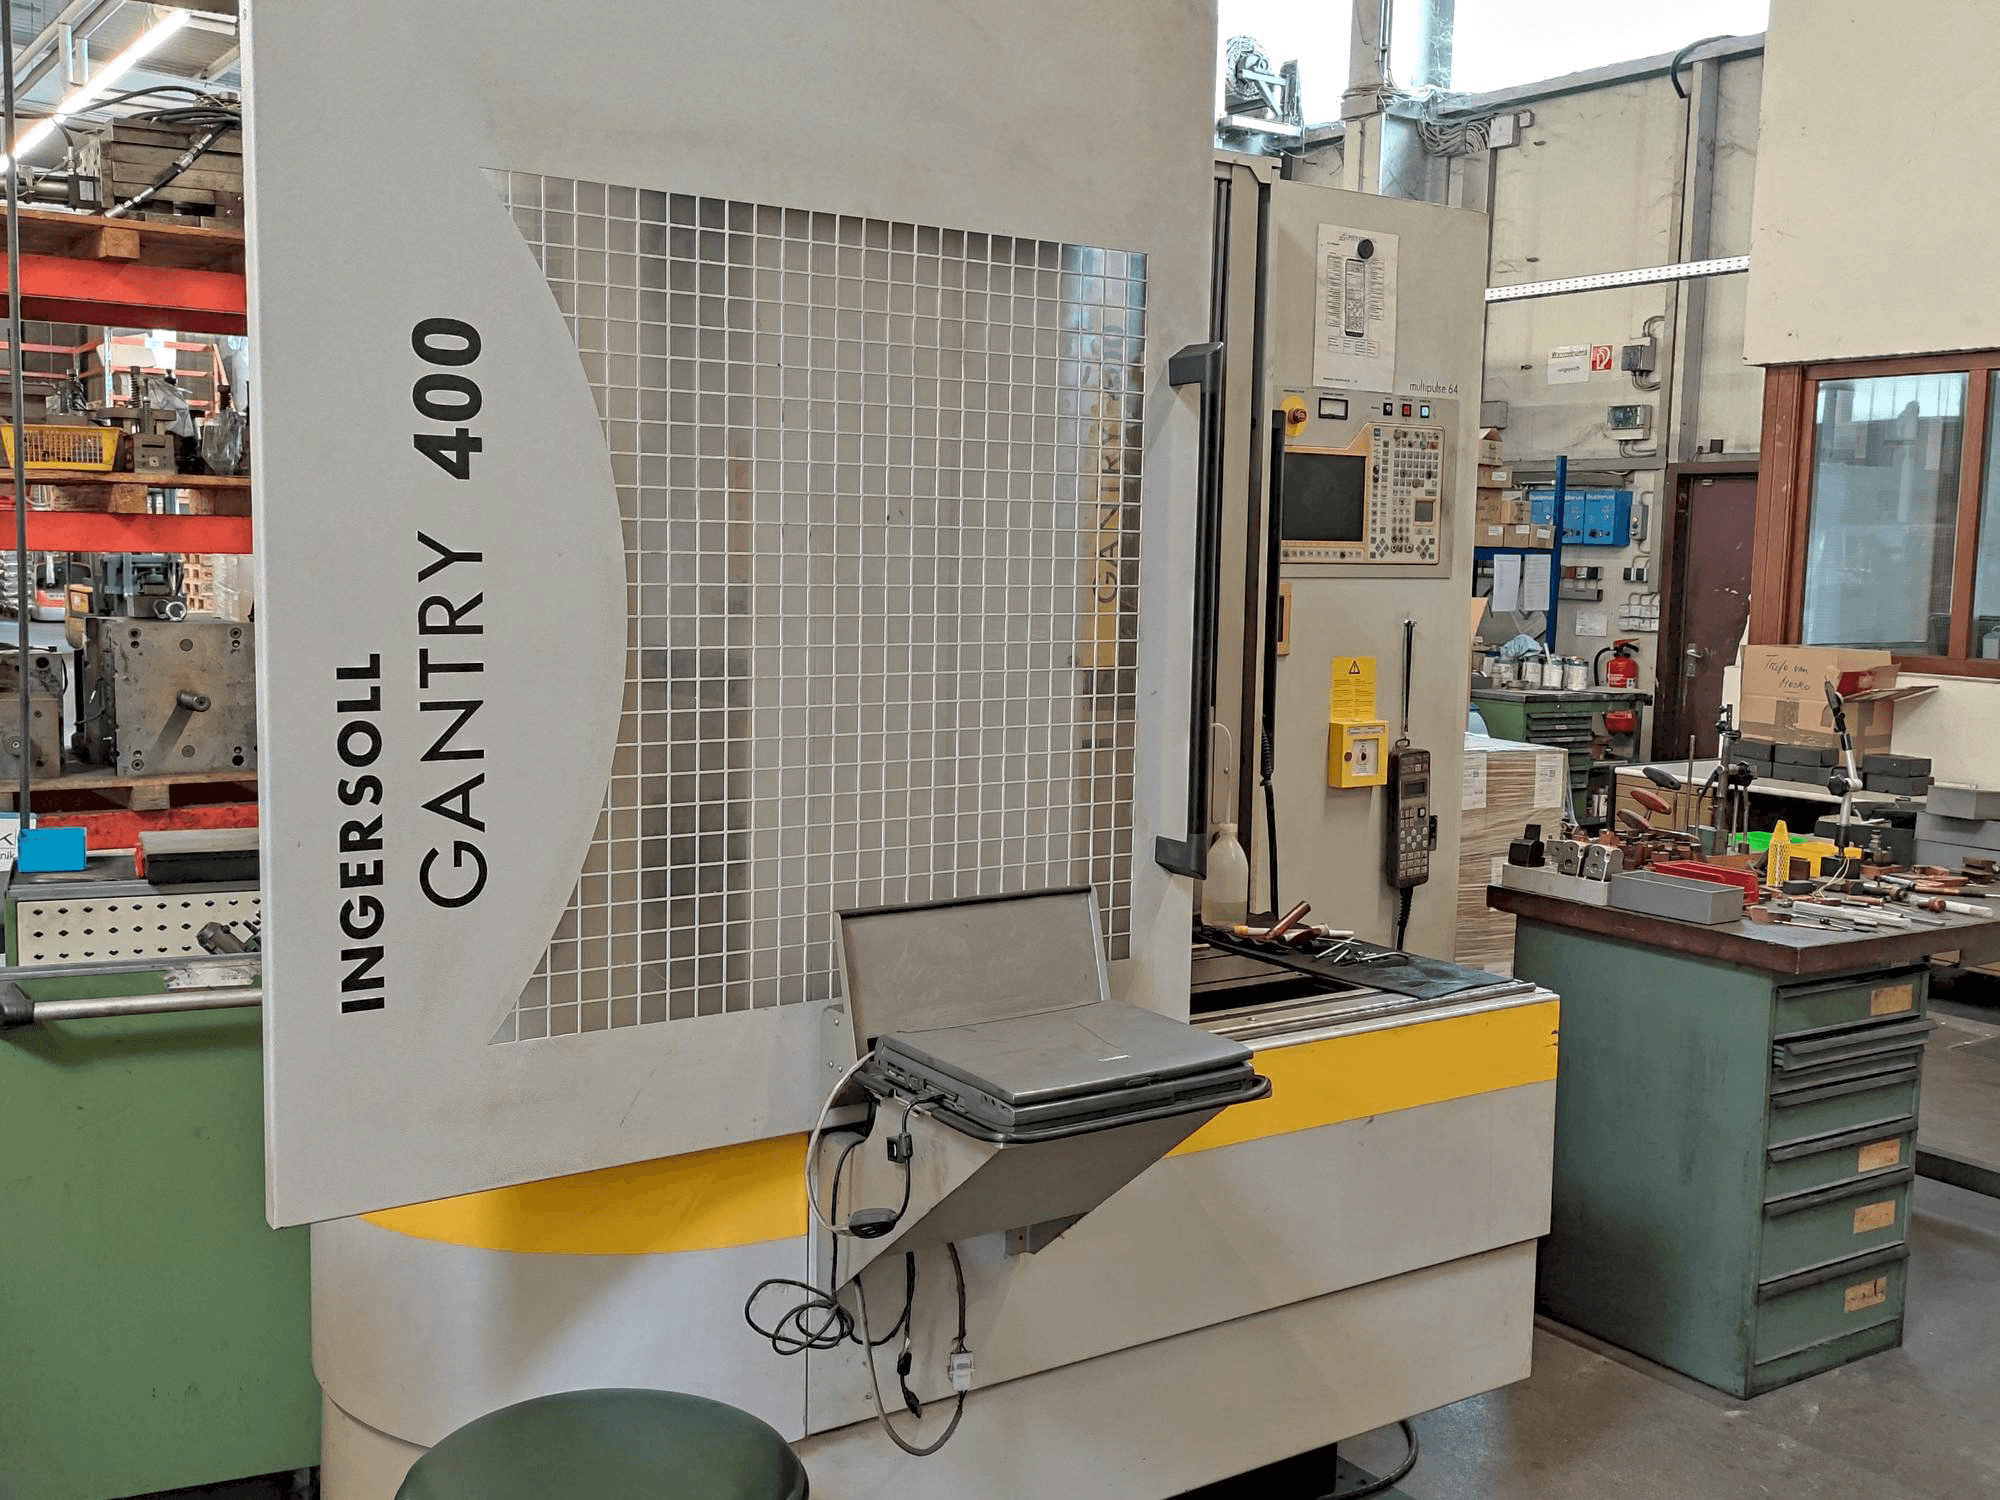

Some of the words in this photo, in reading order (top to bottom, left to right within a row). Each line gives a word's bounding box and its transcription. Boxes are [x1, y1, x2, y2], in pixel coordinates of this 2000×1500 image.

[412, 318, 482, 480] 400
[1409, 379, 1447, 396] multipulse
[1448, 383, 1458, 394] 64
[337, 654, 384, 1013] INGERSOLL
[418, 531, 487, 908] GANTRY
